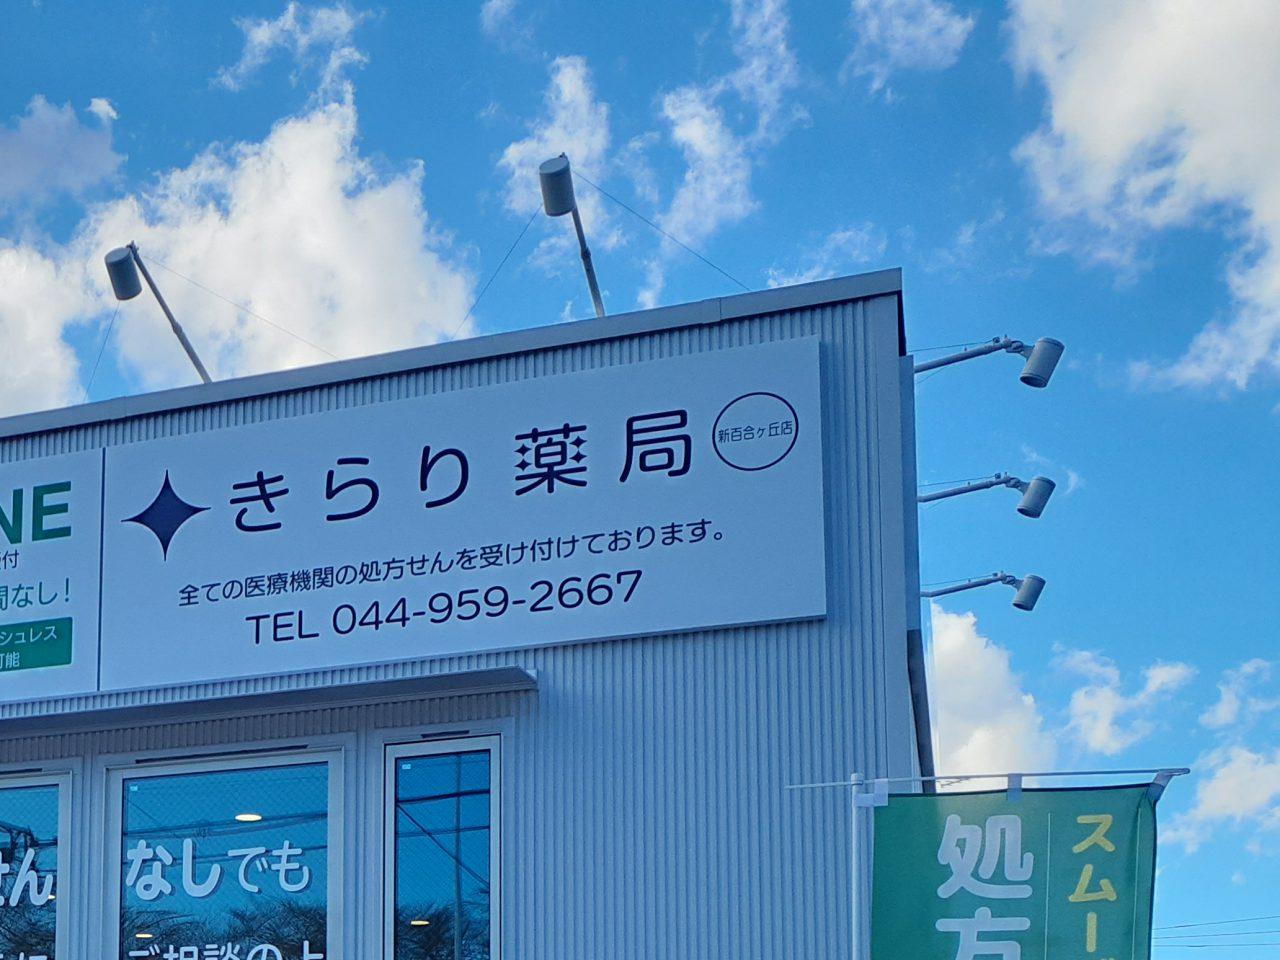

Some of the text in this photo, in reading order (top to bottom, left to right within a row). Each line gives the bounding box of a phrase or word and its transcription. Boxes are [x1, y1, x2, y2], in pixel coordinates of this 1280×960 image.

[717, 419, 793, 444] 新百合ヶ丘店
[229, 409, 692, 532] きらり薬局
[177, 517, 725, 607] 全ての医療機関の処方せんを受け付けております。
[245, 569, 643, 645] TEL 044-959-2667
[125, 838, 310, 900] なしでも
